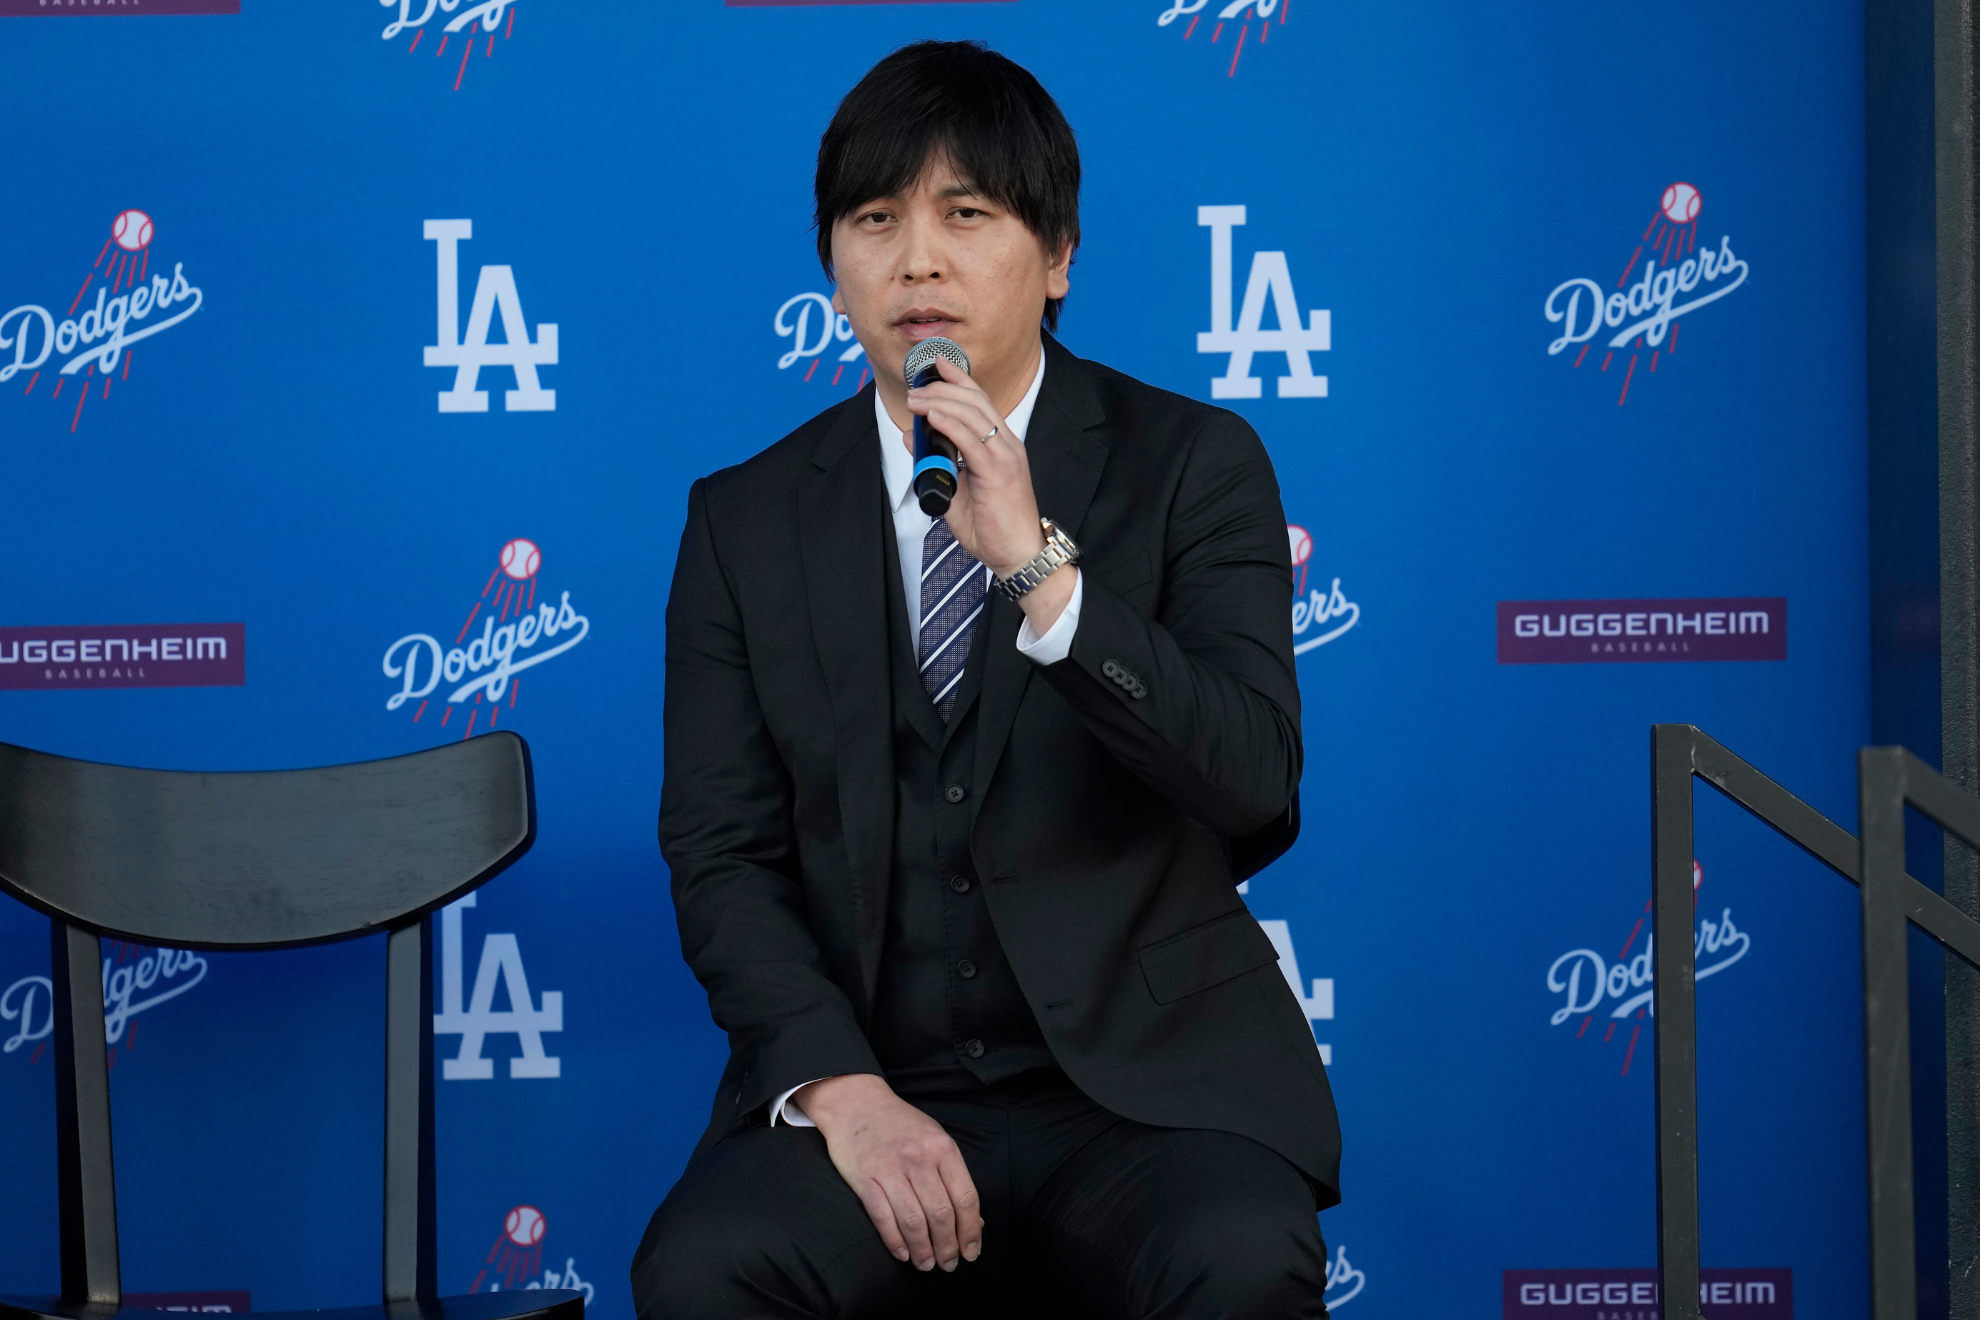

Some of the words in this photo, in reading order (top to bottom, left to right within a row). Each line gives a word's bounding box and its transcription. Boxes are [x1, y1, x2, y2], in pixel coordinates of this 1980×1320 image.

[0, 262, 202, 382] Dodgers
[422, 218, 559, 413] LA
[1196, 204, 1332, 400] LA
[1544, 235, 1749, 356] Dodgers
[0, 637, 227, 663] UGGENHEIM
[44, 667, 146, 680] BASEBALL
[382, 590, 590, 711] Dodgers
[1514, 611, 1769, 637] GUGGENHEIM
[1591, 641, 1690, 653] BASEBALL
[433, 890, 563, 1080] LA
[1546, 907, 1750, 1026] Dodrs
[1520, 1282, 1775, 1305] GUGGEEIM
